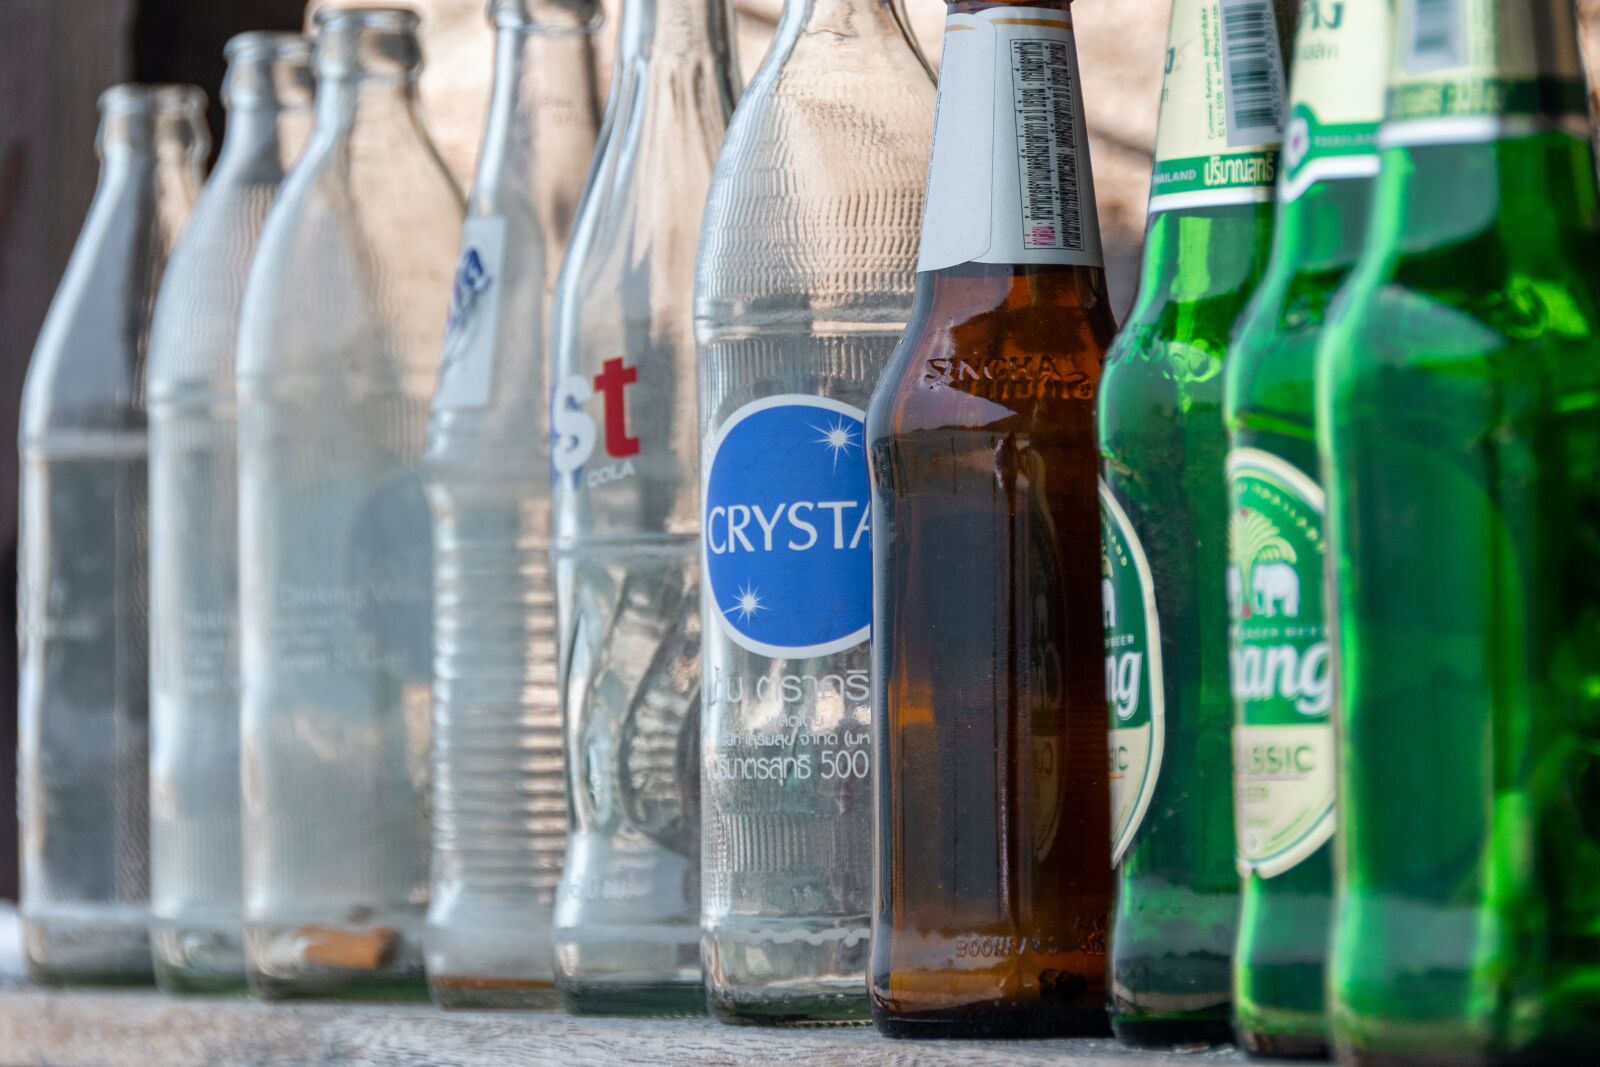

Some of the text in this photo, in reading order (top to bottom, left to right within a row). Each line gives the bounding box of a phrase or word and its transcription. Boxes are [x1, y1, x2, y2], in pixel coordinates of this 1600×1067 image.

[551, 357, 641, 477] st
[587, 459, 636, 488] COLA
[708, 500, 870, 554] CRYSTA
[756, 669, 870, 704] ตราคริ
[800, 730, 838, 745] จำกัด
[844, 730, 870, 747] (มห
[820, 750, 869, 779] 500
